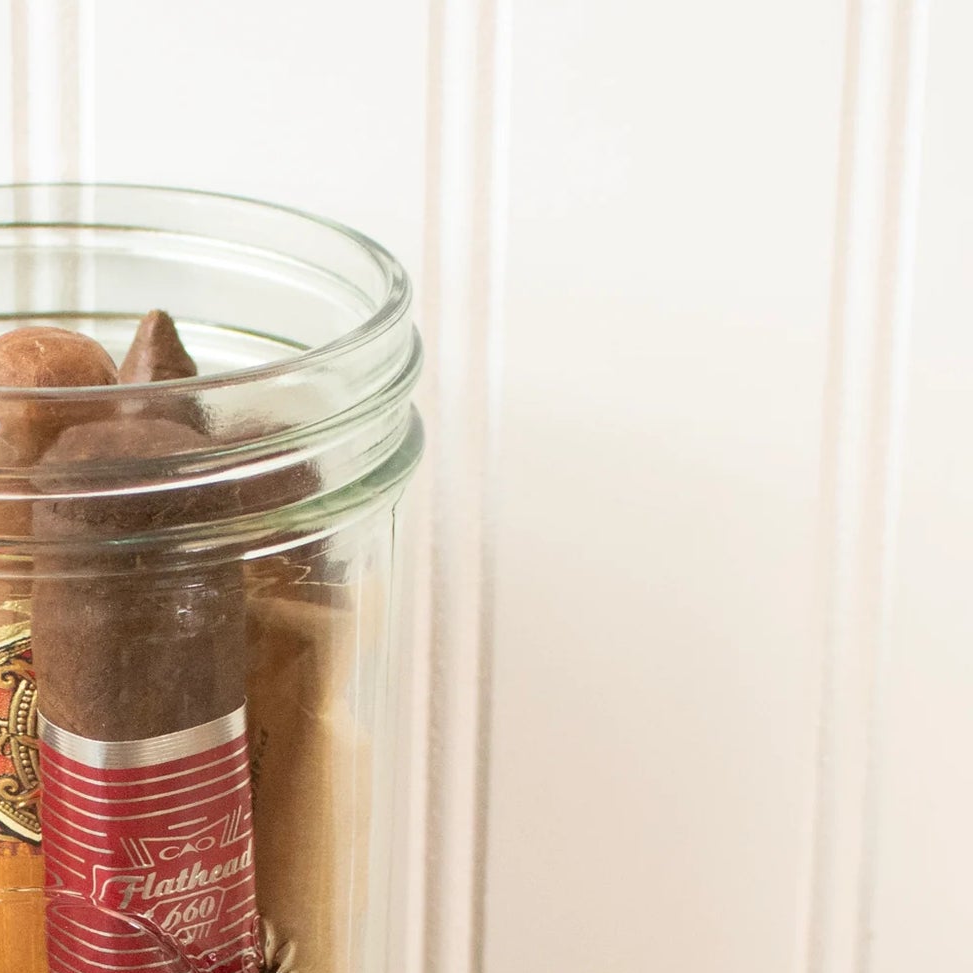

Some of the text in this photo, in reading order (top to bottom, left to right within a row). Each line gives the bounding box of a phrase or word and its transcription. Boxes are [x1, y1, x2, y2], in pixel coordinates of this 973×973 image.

[159, 836, 216, 861] CAO
[98, 837, 253, 910] Flathead
[160, 896, 216, 931] 660
